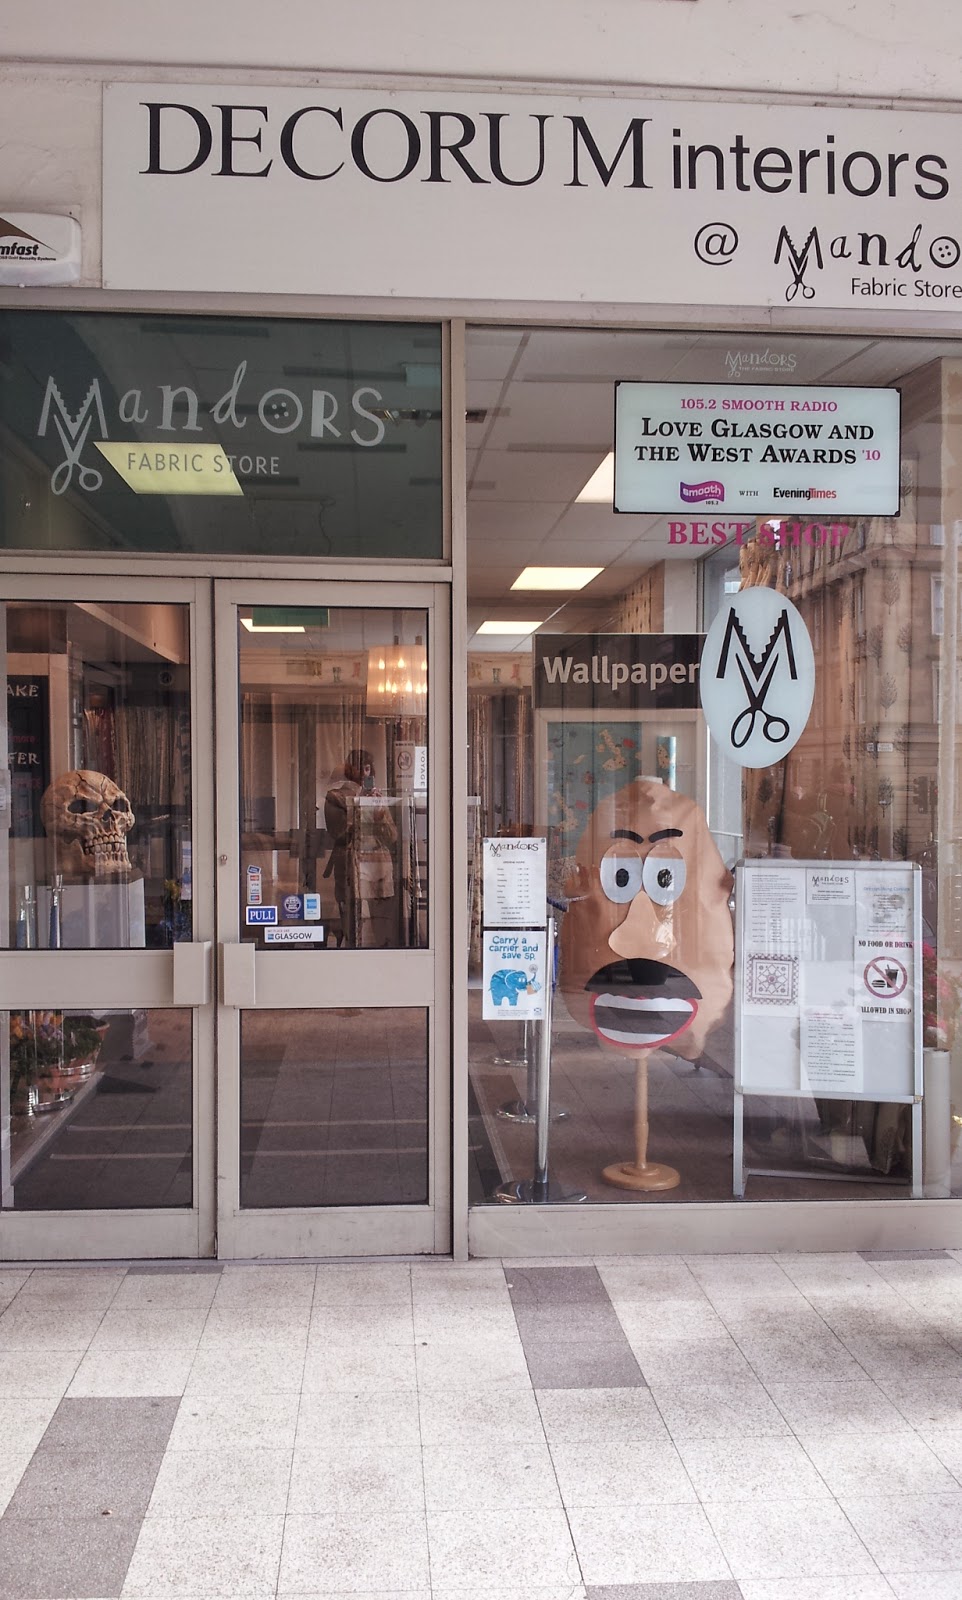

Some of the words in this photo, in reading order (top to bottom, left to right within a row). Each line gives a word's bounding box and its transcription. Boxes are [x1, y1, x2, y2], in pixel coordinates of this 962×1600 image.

[139, 102, 653, 189] DECORUM
[672, 128, 950, 200] interiors
[694, 222, 739, 265] @
[851, 276, 908, 297] Fabric
[914, 279, 962, 299] Store
[680, 398, 717, 411] 105.2
[722, 399, 785, 412] SMOOTH
[791, 400, 838, 413] RADIO
[641, 417, 703, 437] LOVE
[711, 419, 823, 439] GLASGOW
[828, 424, 874, 440] AND
[634, 446, 680, 461] THE
[687, 443, 753, 463] WEST
[760, 444, 857, 464] AWARDS
[127, 453, 204, 473] FABRIC
[213, 455, 281, 476] STORE
[683, 485, 721, 496] smooth
[668, 522, 750, 545] BEST
[758, 522, 849, 547] SHOP
[543, 655, 700, 691] Wallpaper
[250, 910, 275, 920] PULL
[492, 936, 519, 946] Carry
[522, 944, 539, 952] and
[867, 940, 883, 948] FOOD
[888, 1007, 895, 1015] IN
